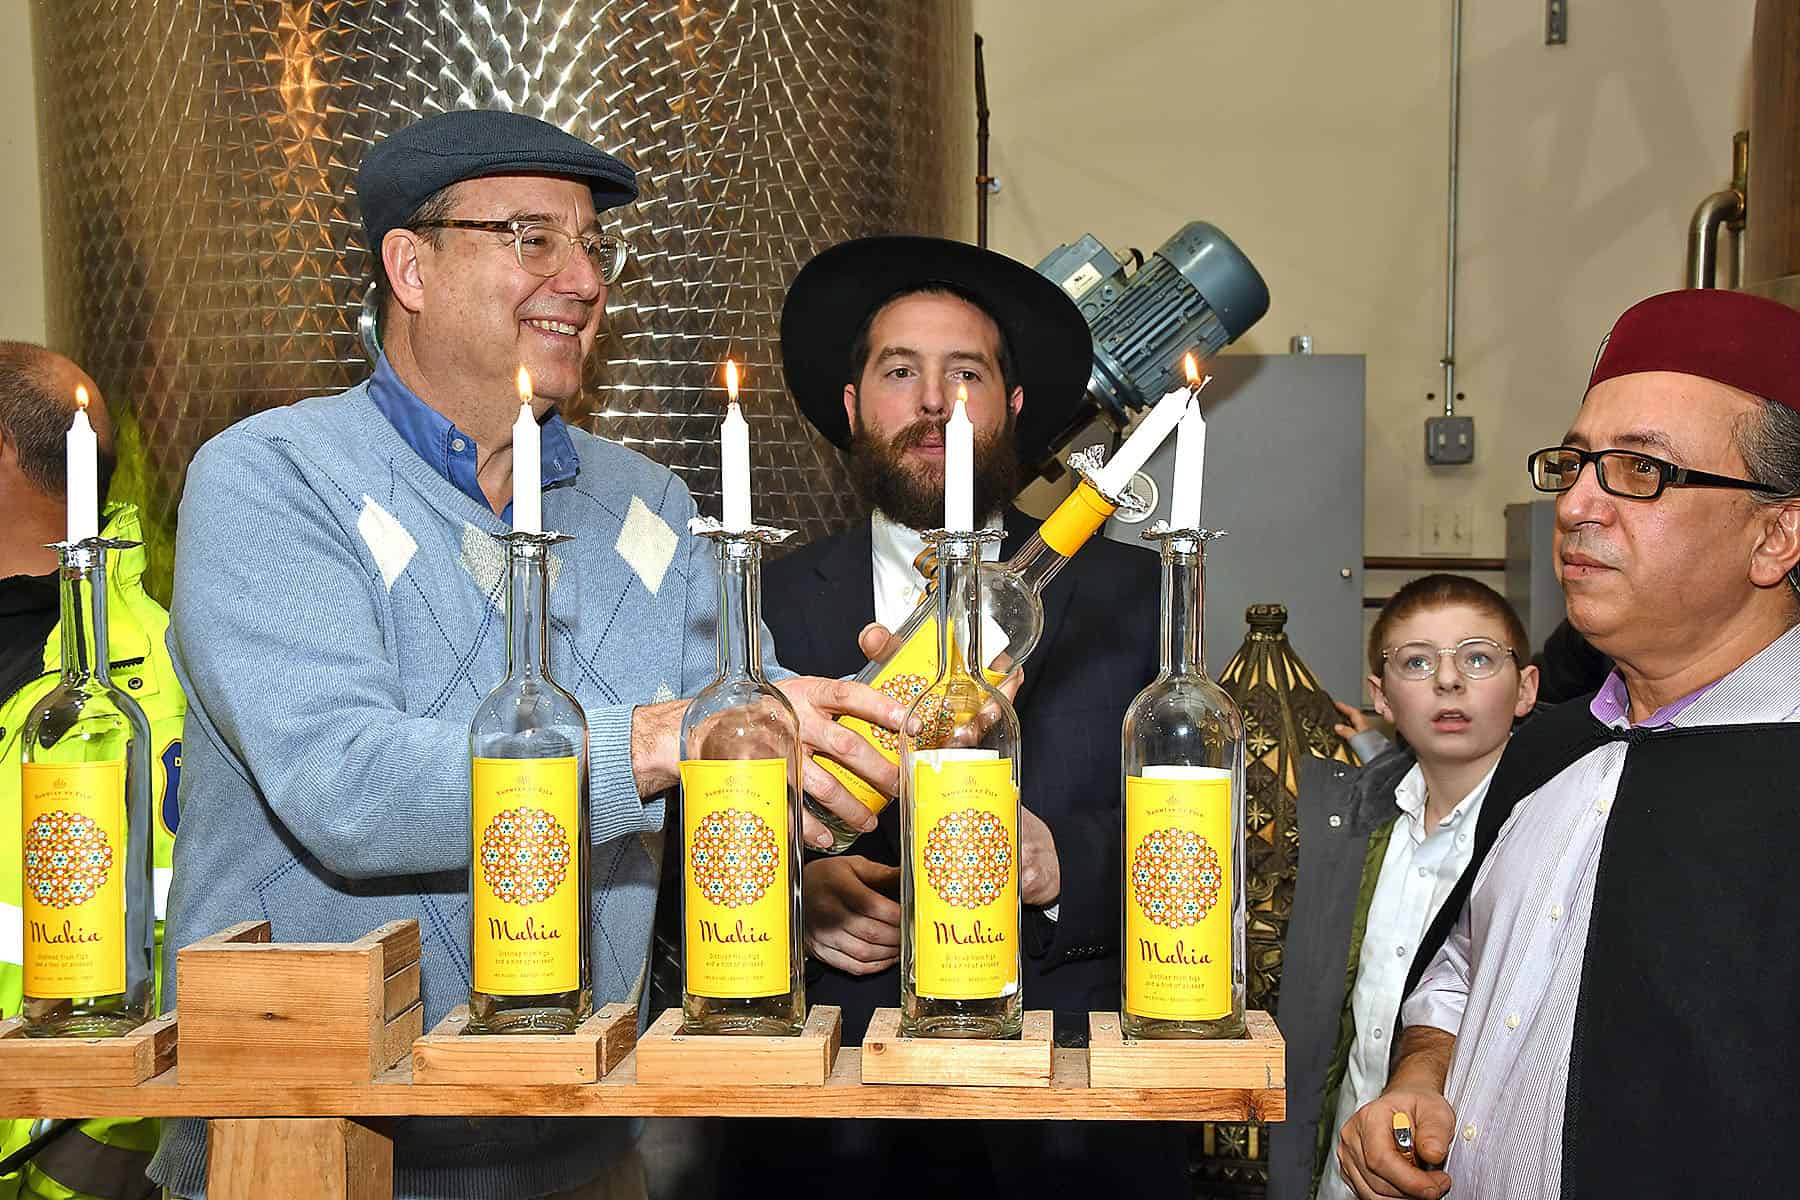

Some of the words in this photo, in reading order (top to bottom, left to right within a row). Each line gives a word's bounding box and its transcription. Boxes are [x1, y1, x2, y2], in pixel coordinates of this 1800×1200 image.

[30, 920, 102, 944] Mahia
[488, 916, 561, 941] Mahia
[698, 919, 771, 943] Mahia
[933, 920, 1006, 944] Mahia
[1138, 938, 1213, 964] Mahia
